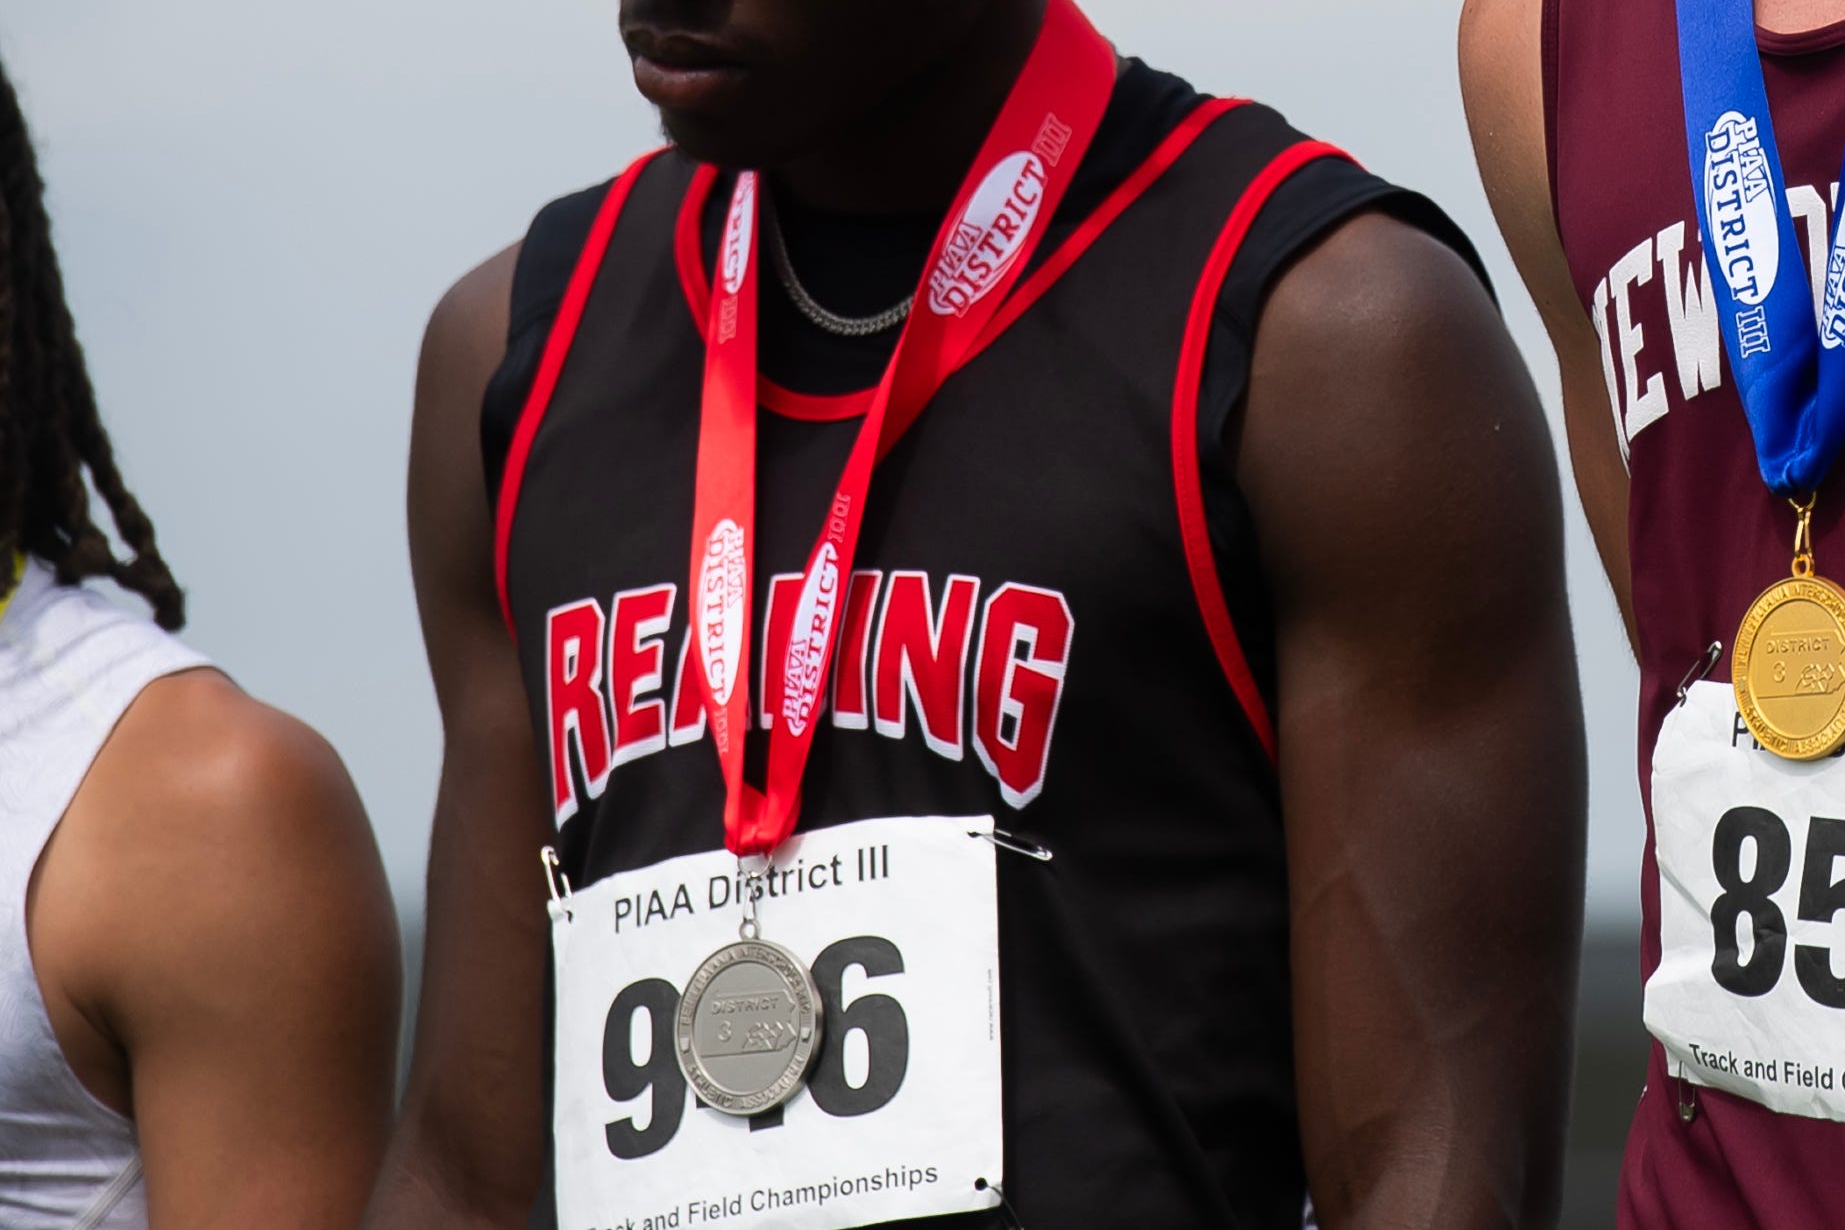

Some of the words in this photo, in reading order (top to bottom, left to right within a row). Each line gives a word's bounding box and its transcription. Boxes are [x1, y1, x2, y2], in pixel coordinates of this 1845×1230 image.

[1734, 116, 1769, 204] PIAA
[942, 158, 1049, 317] DISTRICT
[1706, 126, 1760, 301] DISTRICT
[1735, 305, 1772, 359] III
[705, 535, 728, 703] DISTRICT
[798, 545, 841, 722] DISTRICT
[1766, 637, 1831, 656] DISTRICT
[1771, 659, 1787, 684] 3
[614, 883, 695, 934] PIAA
[708, 853, 843, 911] District
[857, 844, 889, 882] III
[602, 935, 909, 1160] 96
[710, 996, 780, 1016] DISTRICT
[716, 1019, 733, 1043] 3
[1688, 1042, 1738, 1075] Track
[1743, 1059, 1778, 1082] and
[1783, 1061, 1834, 1090] Field
[642, 1206, 680, 1230] and
[688, 1194, 743, 1225] Field
[750, 1164, 939, 1212] Championships
